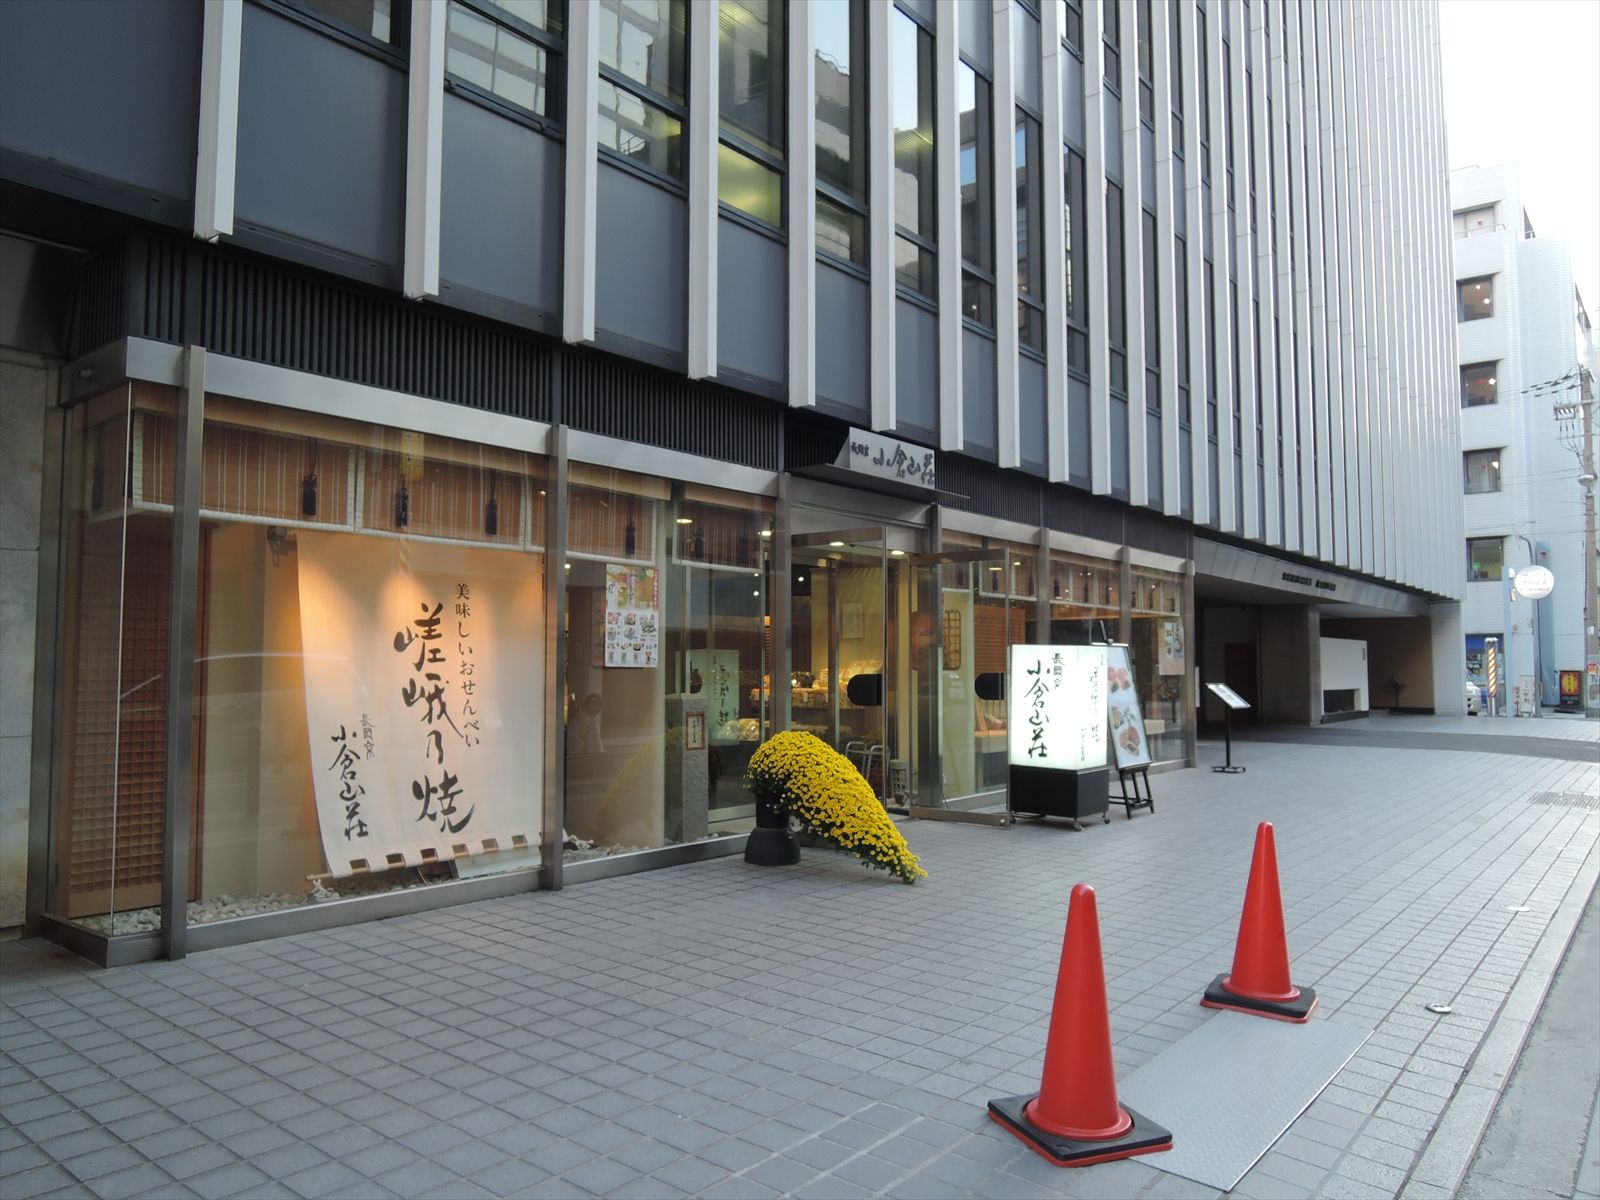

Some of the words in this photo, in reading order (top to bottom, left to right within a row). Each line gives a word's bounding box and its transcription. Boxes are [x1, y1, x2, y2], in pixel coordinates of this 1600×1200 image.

[872, 443, 935, 485] 小倉山荘
[393, 602, 475, 834] 嵯峨乃焼
[454, 583, 481, 749] 美味しいおせんべい
[1023, 659, 1051, 760] 小倉山荘
[328, 724, 369, 842] 小倉山荘
